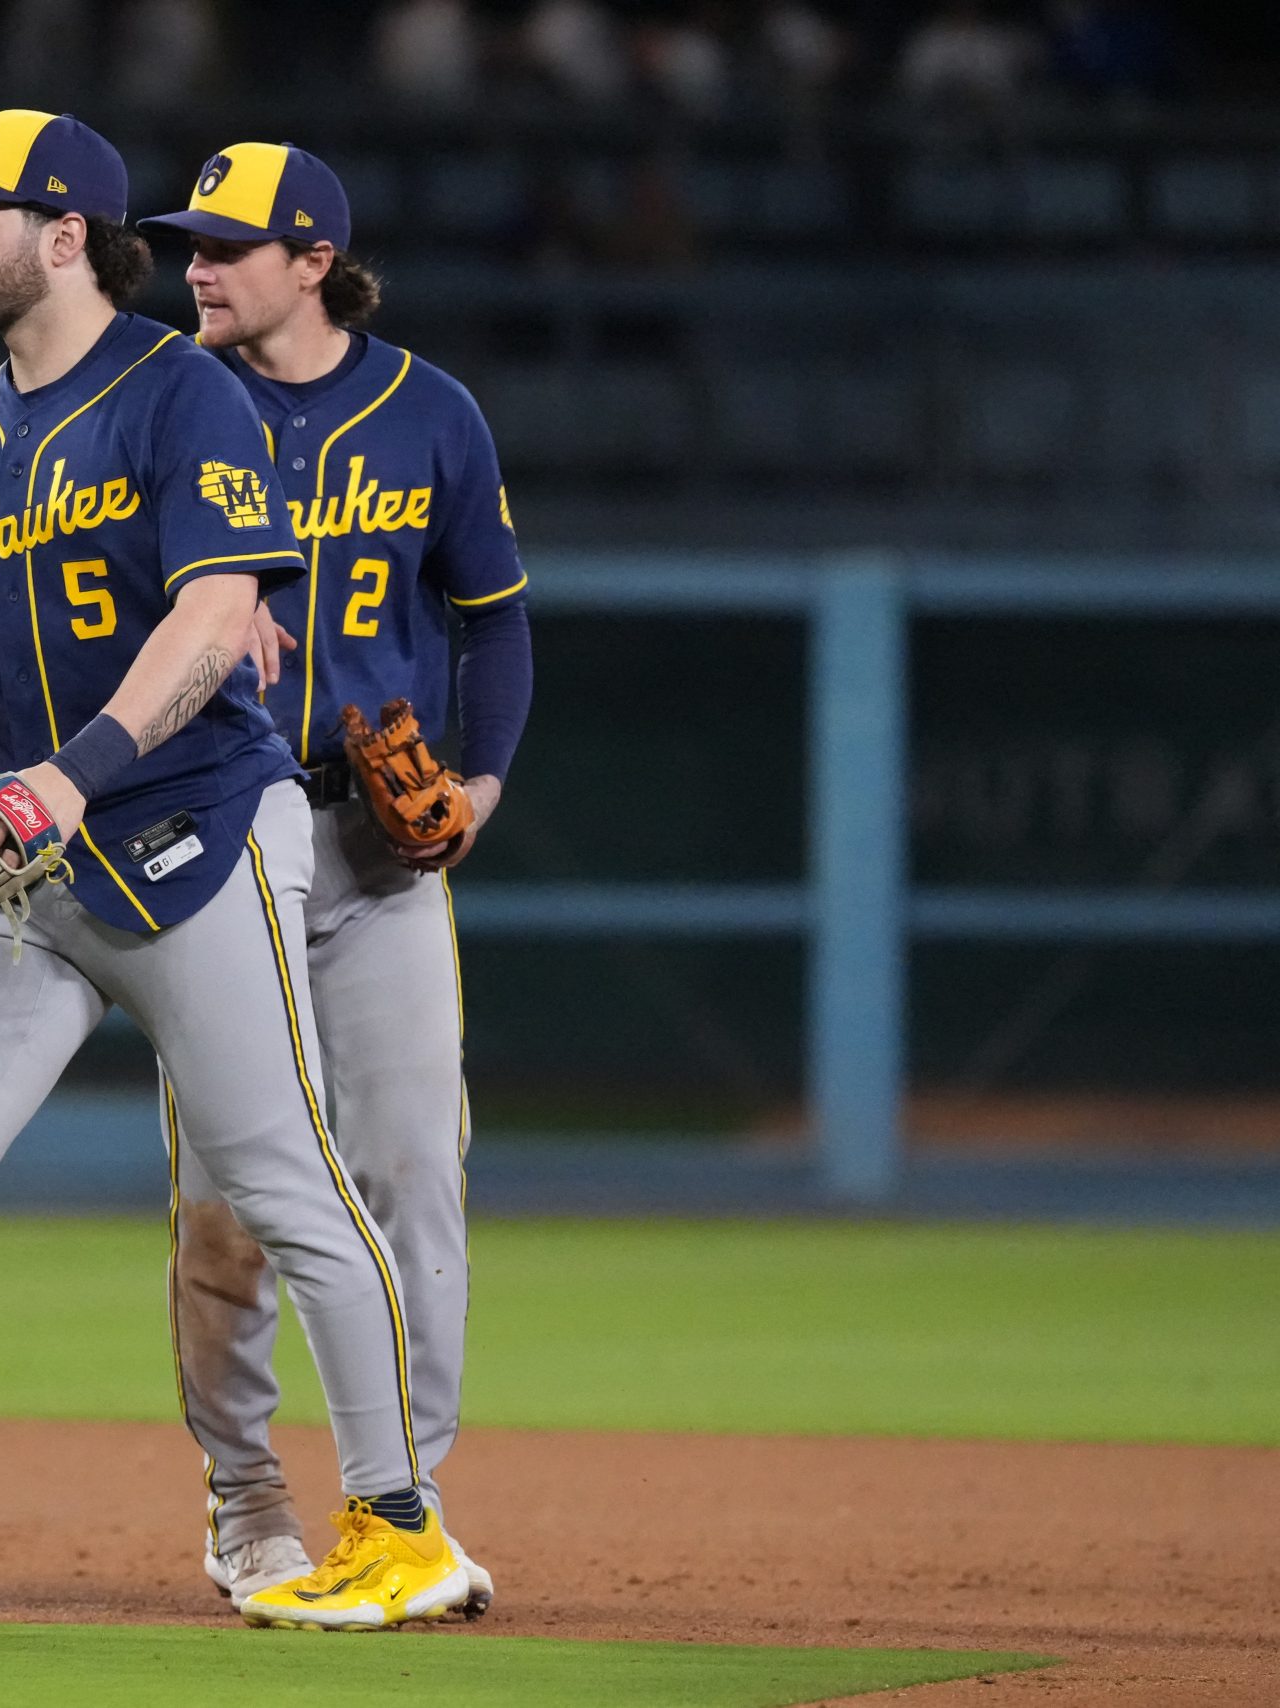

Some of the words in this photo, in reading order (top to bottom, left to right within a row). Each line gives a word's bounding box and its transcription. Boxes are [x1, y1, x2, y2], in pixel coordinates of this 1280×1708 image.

[219, 471, 260, 515] M
[61, 558, 118, 640] 5
[342, 557, 390, 638] 2
[1, 793, 42, 828] Rawlings
